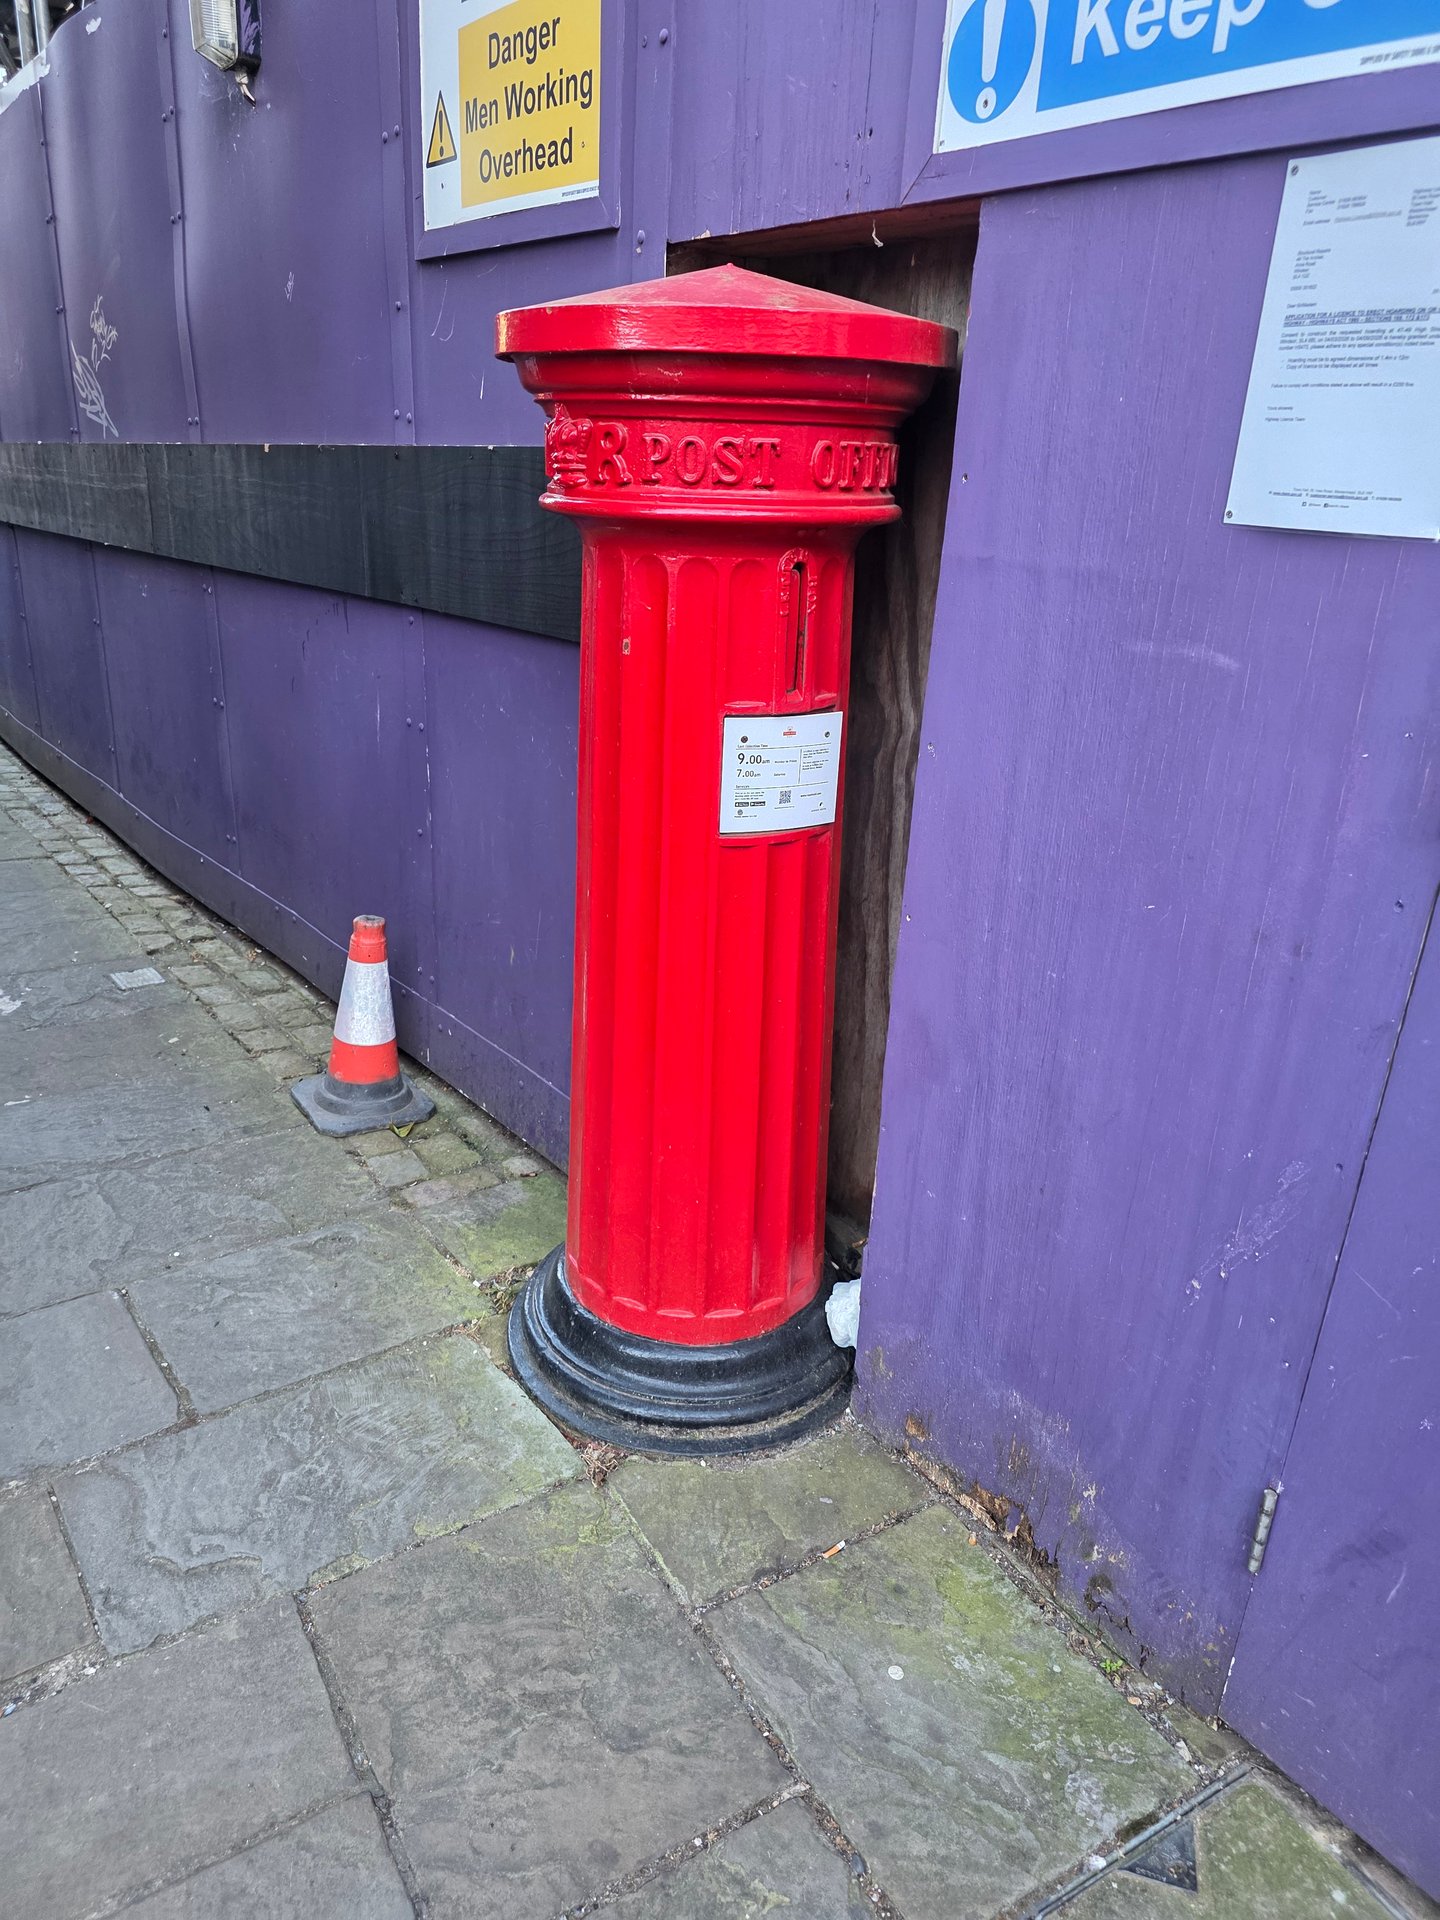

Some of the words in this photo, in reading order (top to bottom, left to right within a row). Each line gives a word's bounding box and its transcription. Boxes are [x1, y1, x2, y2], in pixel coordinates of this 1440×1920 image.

[488, 16, 561, 70] Danger
[1071, 0, 1265, 65] Keep
[465, 97, 499, 134] Men
[504, 68, 593, 121] Working
[479, 126, 573, 184] Overhead
[594, 421, 634, 487] R
[641, 432, 782, 491] POST
[810, 439, 899, 491] OFFI
